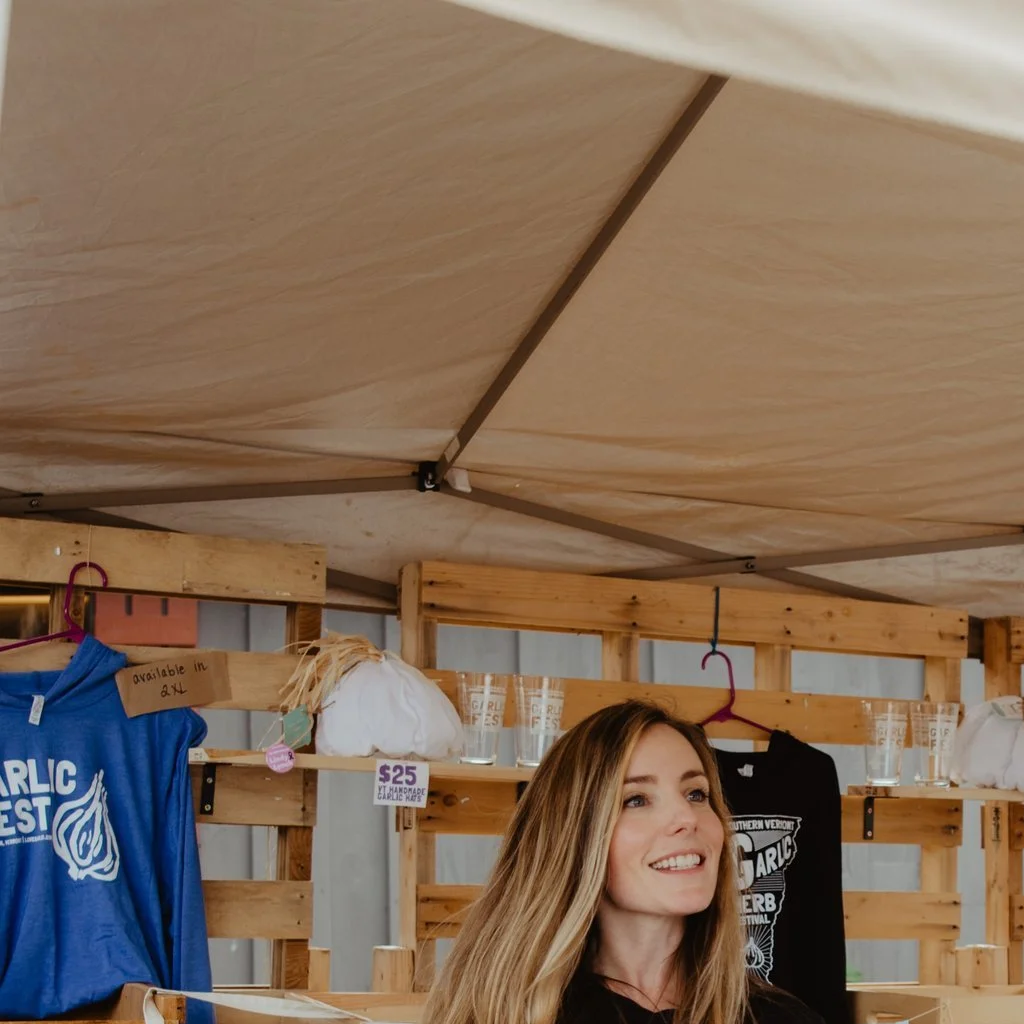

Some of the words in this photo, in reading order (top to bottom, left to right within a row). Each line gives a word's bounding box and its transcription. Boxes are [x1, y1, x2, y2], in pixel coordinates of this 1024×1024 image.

[132, 664, 186, 685] available
[194, 660, 208, 673] in
[160, 682, 187, 698] 2XL
[378, 763, 417, 786] $25
[389, 786, 427, 796] HANDMADE
